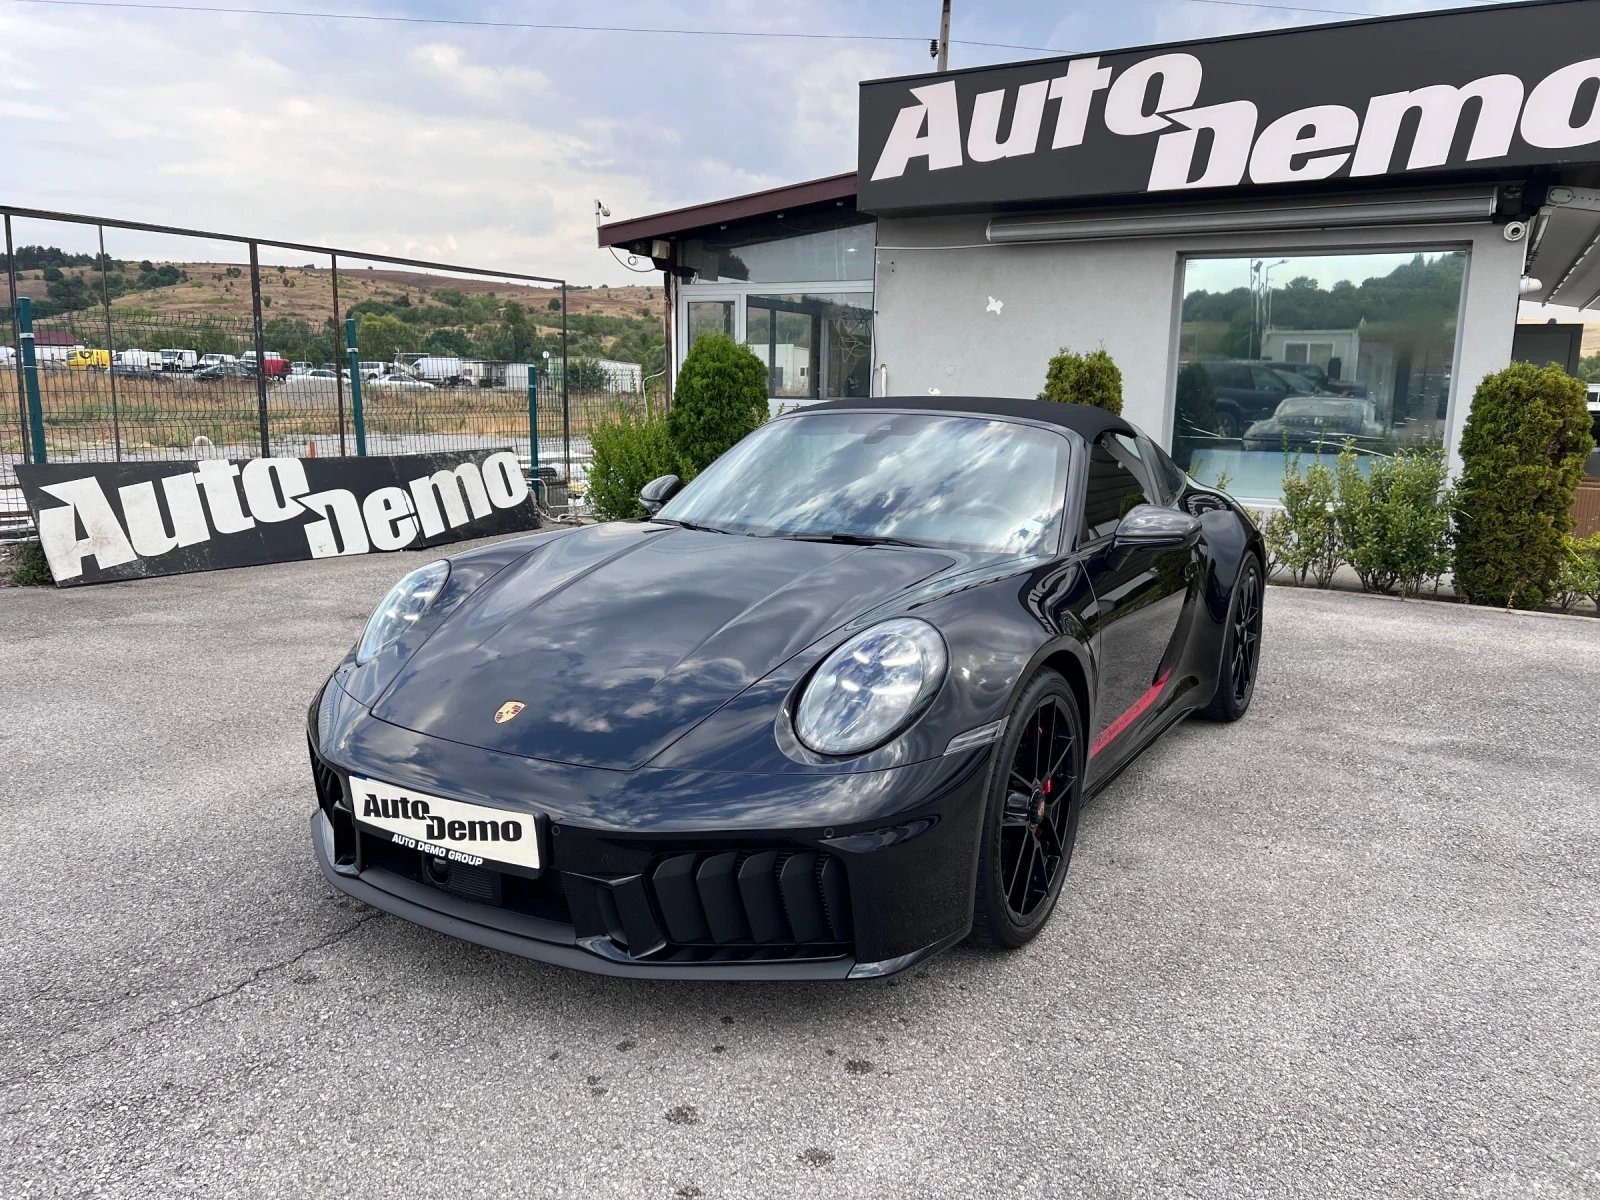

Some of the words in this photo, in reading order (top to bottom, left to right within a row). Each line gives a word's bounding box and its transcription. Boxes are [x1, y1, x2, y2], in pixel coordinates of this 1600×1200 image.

[870, 53, 1203, 182] Auto
[1147, 57, 1600, 192] Demo
[39, 457, 310, 582] Auto
[298, 451, 531, 560] Demo
[363, 793, 430, 820] Auto
[426, 815, 522, 842] Demo
[391, 834, 415, 848] AUTO
[417, 842, 446, 856] DEMO
[448, 850, 483, 866] GROUP
